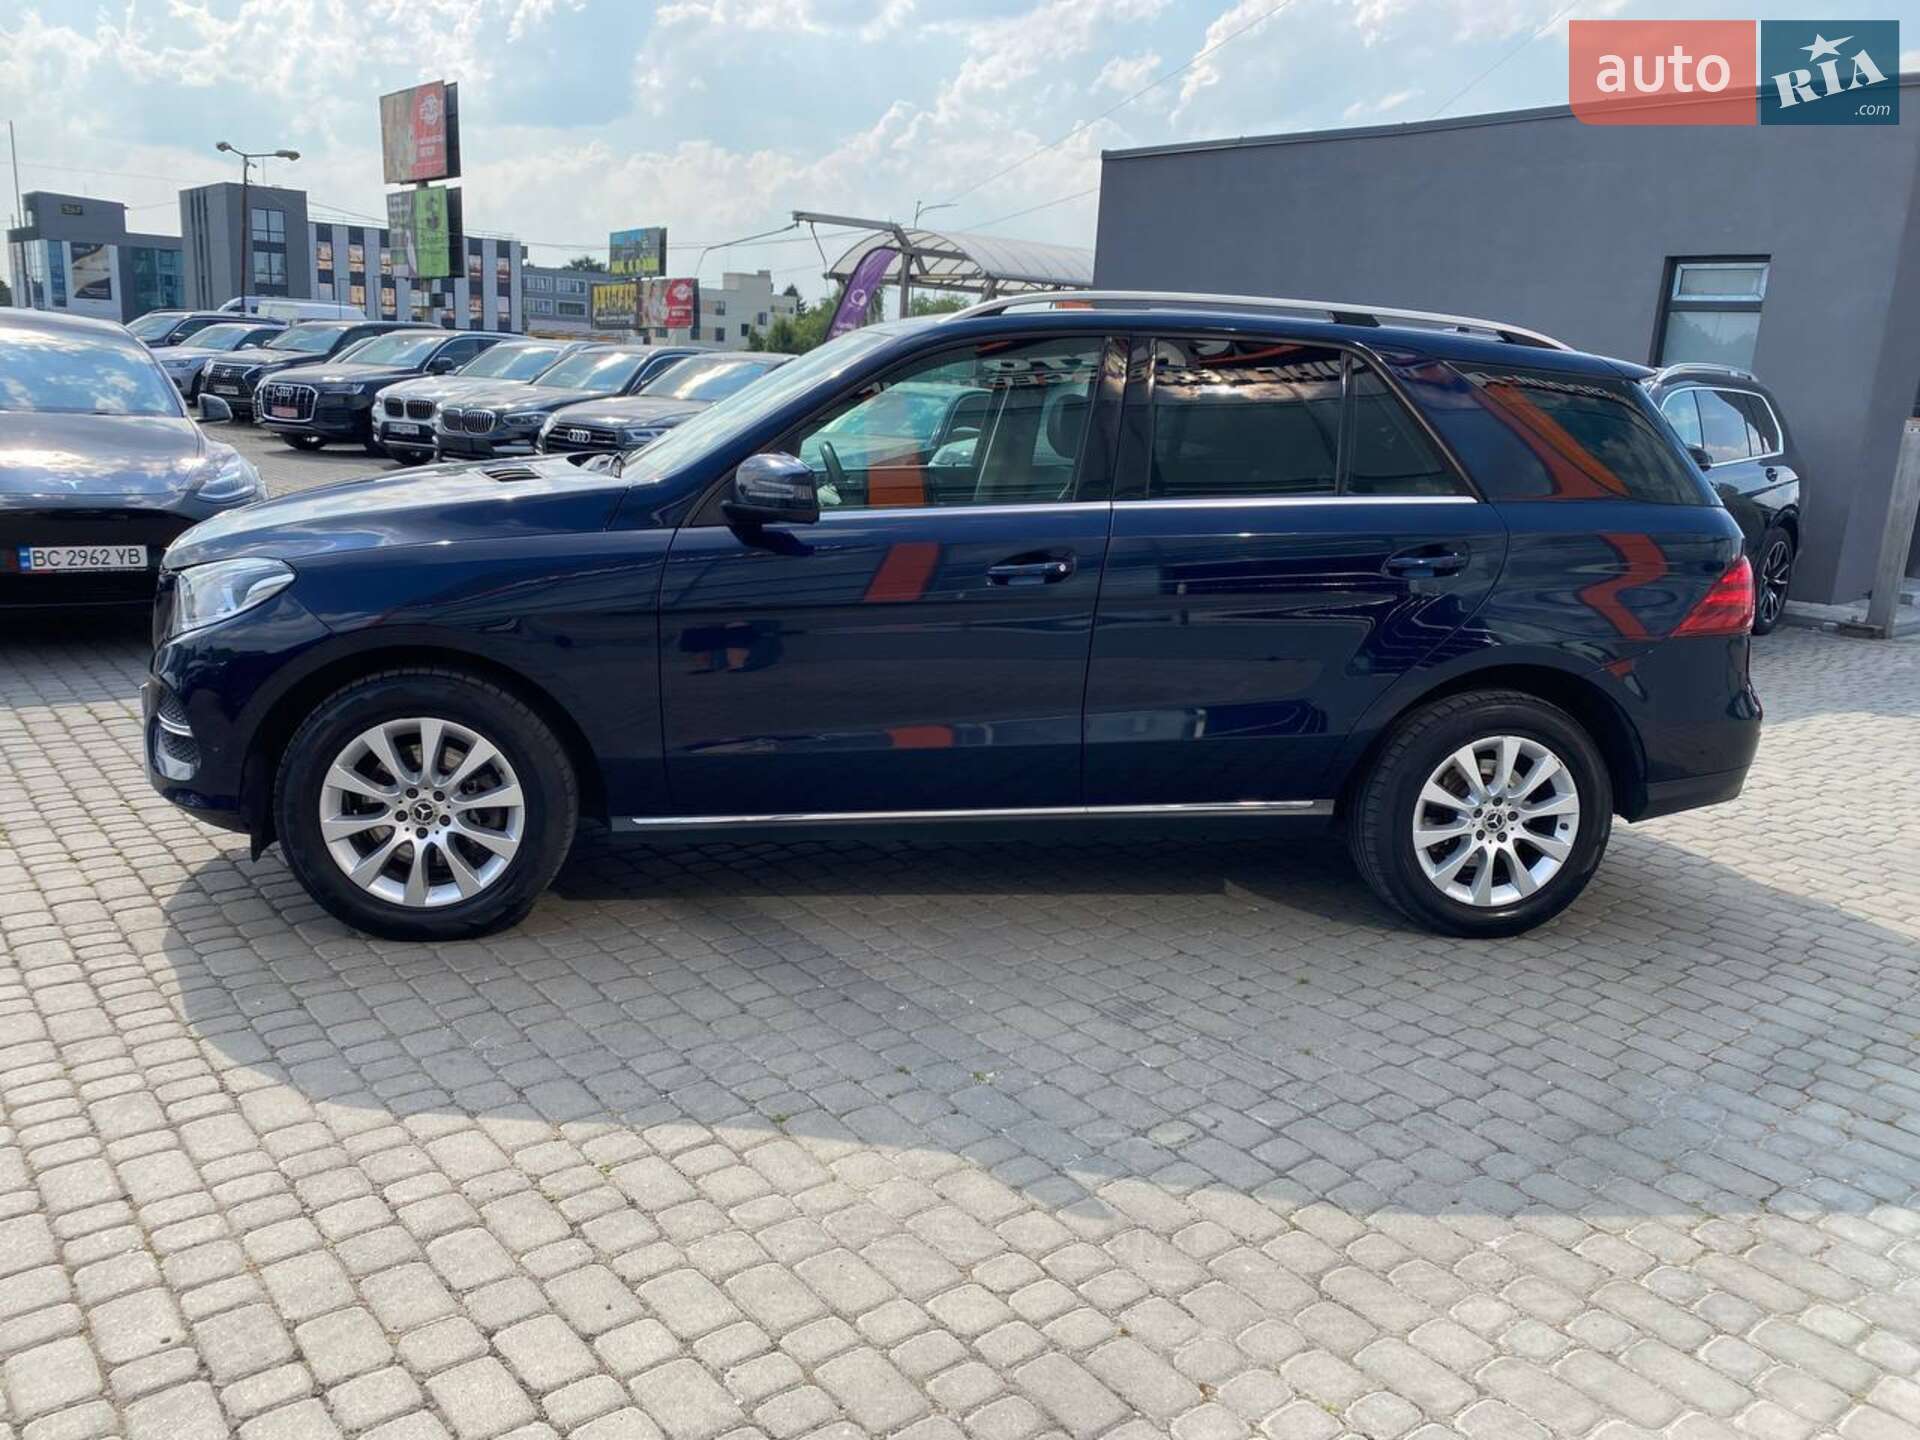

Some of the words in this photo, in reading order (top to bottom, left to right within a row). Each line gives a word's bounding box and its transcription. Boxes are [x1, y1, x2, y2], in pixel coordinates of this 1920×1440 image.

[32, 550, 61, 567] BC
[66, 548, 110, 566] 2962
[116, 548, 141, 565] YB
